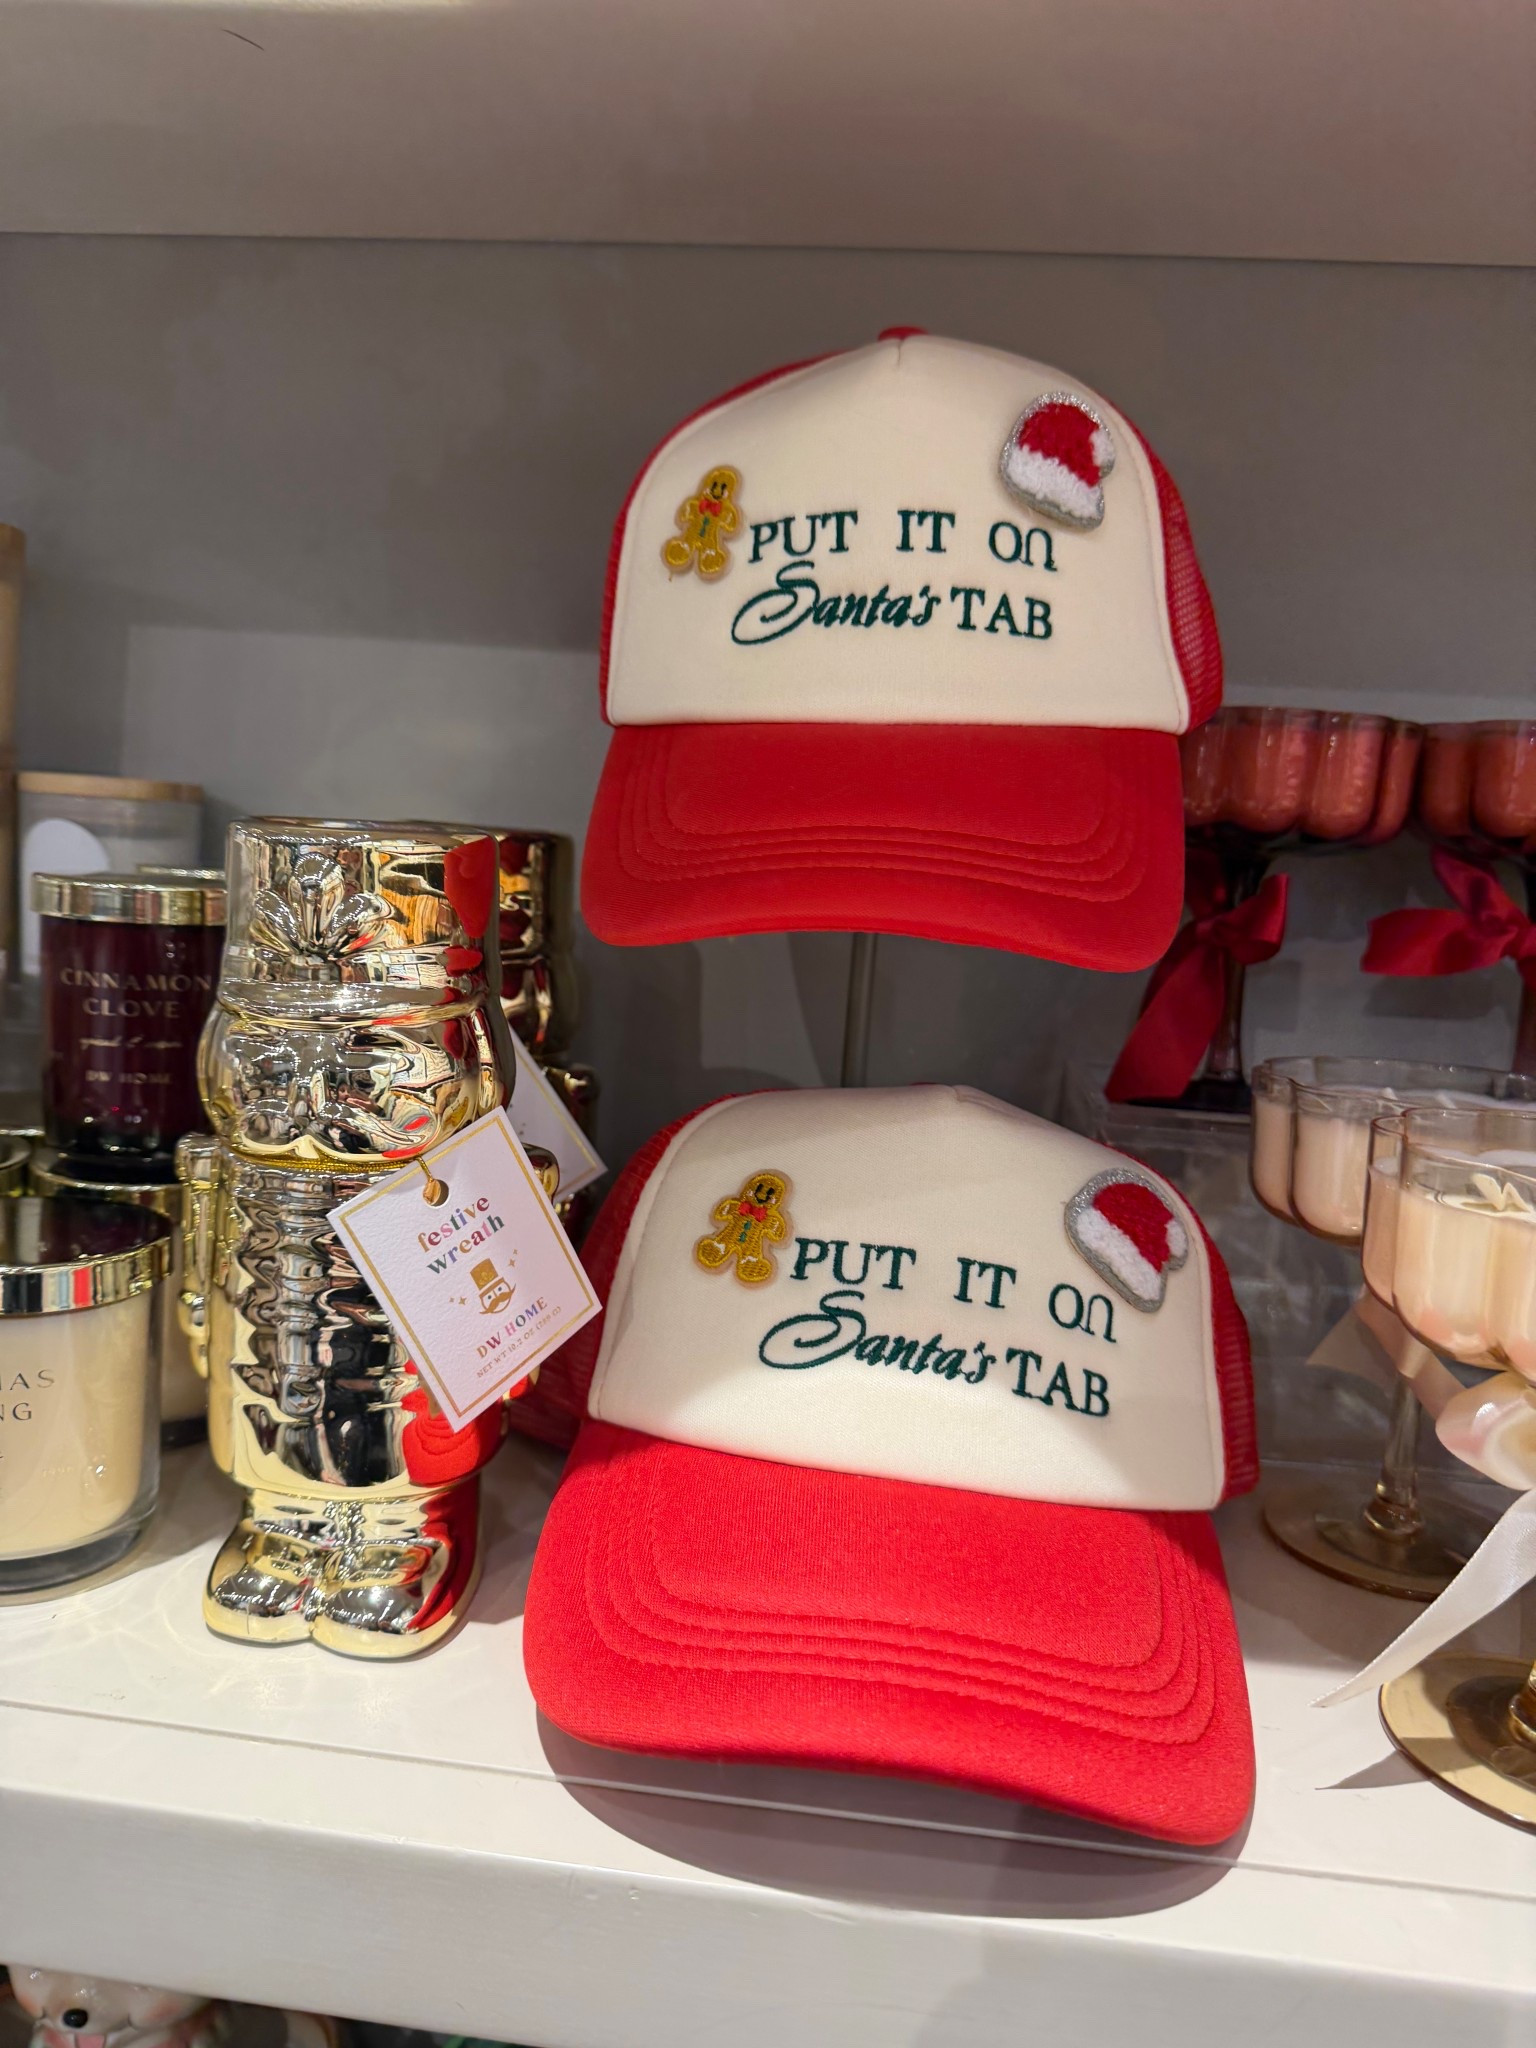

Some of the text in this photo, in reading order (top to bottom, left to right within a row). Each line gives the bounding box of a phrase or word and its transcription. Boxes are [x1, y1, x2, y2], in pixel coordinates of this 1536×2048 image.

[747, 510, 858, 563] PUT
[896, 509, 955, 553] IT
[731, 560, 1053, 645] Santa's TAB
[59, 967, 211, 991] CINNAMON
[82, 997, 181, 1018] CLOVE
[417, 1197, 490, 1253] festive
[427, 1214, 505, 1275] wreath
[789, 1237, 916, 1290] PUT
[953, 1256, 1017, 1308] IT
[475, 1296, 549, 1360] DW HOME
[758, 1289, 1110, 1417] Santa's TAB
[0, 1369, 56, 1391] AS
[476, 1363, 495, 1379] NET
[494, 1351, 508, 1364] WT
